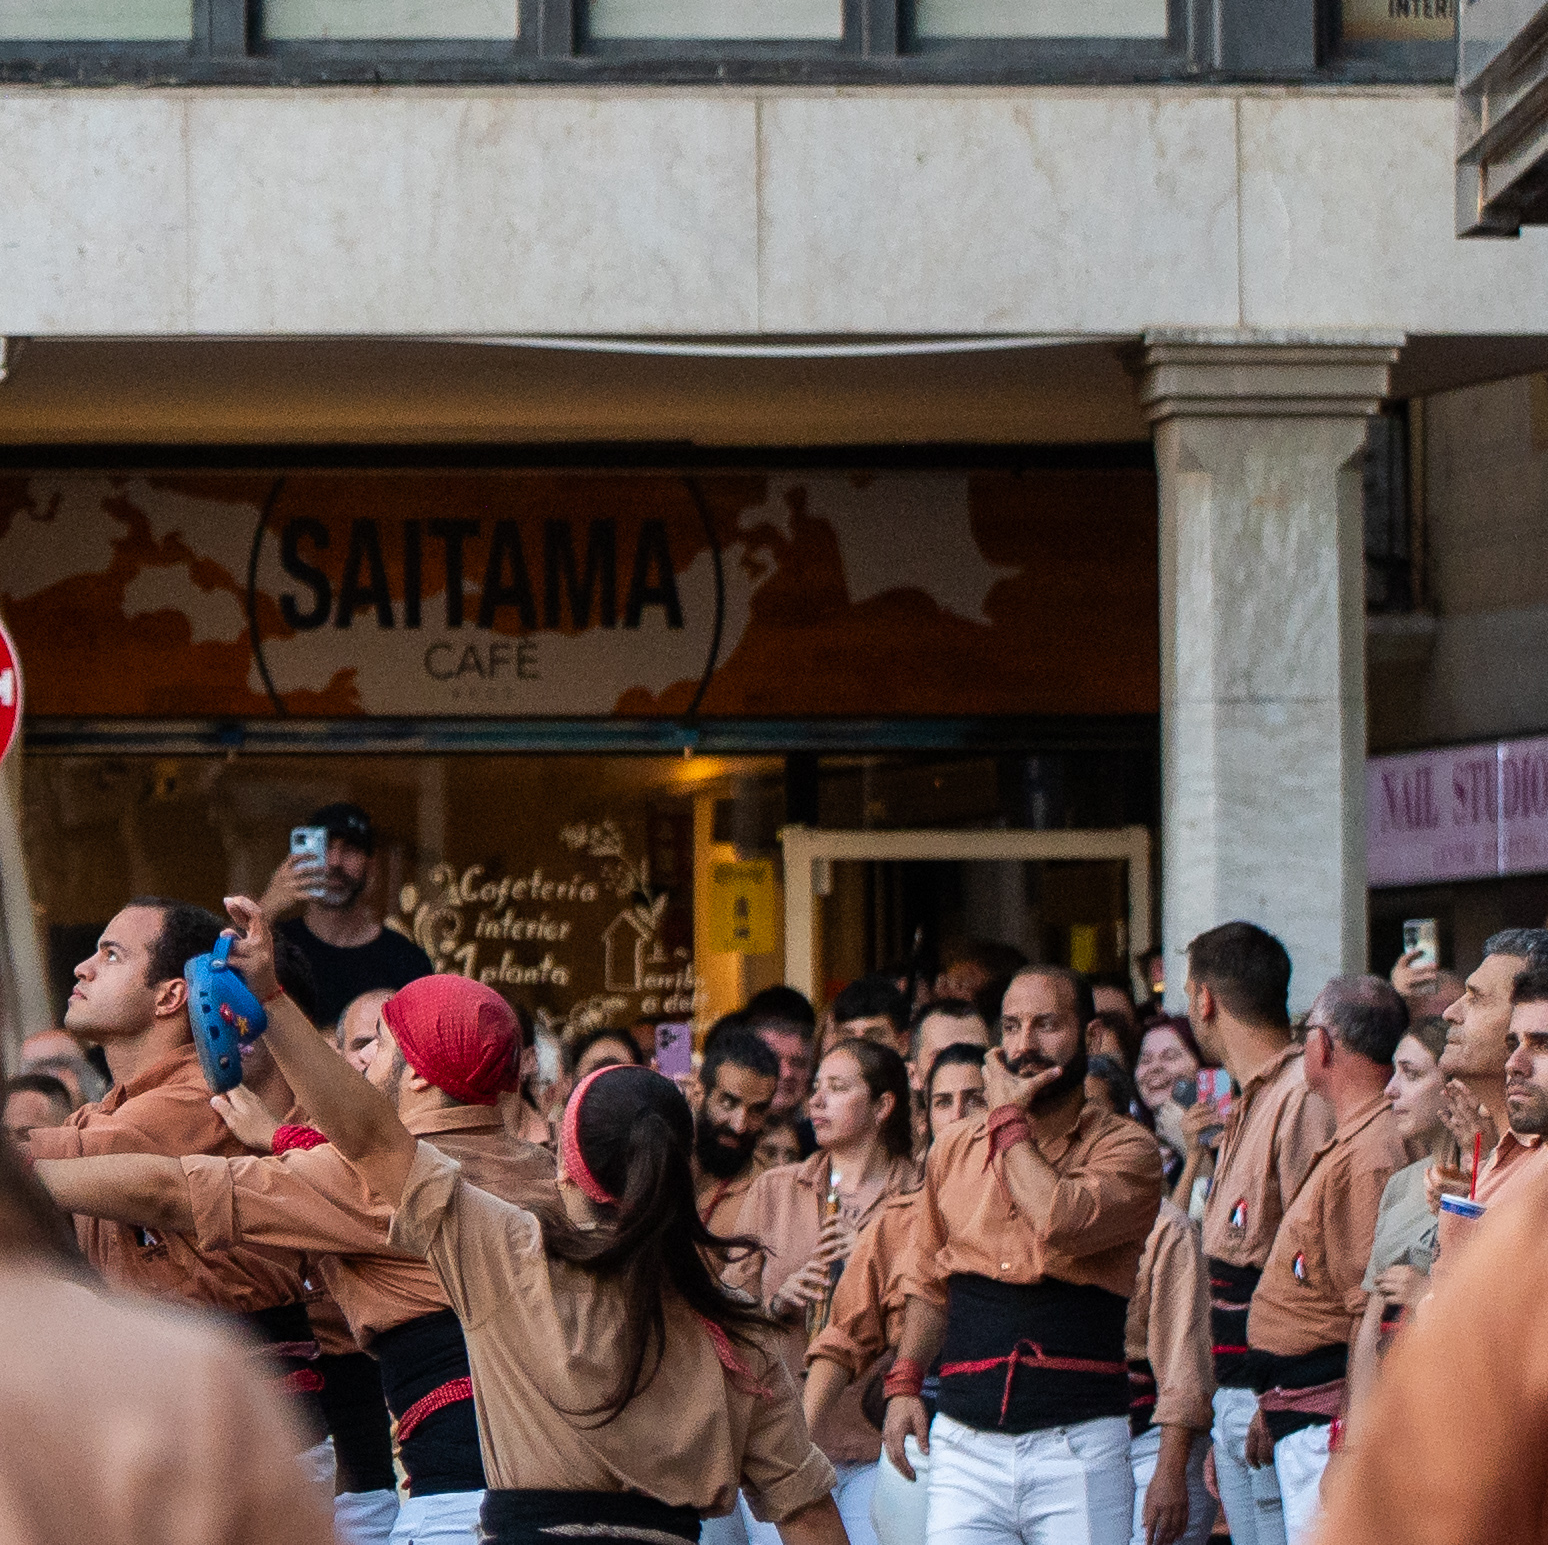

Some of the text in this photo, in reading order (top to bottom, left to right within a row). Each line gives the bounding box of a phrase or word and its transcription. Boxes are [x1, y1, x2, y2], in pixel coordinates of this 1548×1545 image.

[277, 516, 685, 630] SAITAMA
[1380, 766, 1440, 835] NAIL
[474, 906, 572, 942] interior
